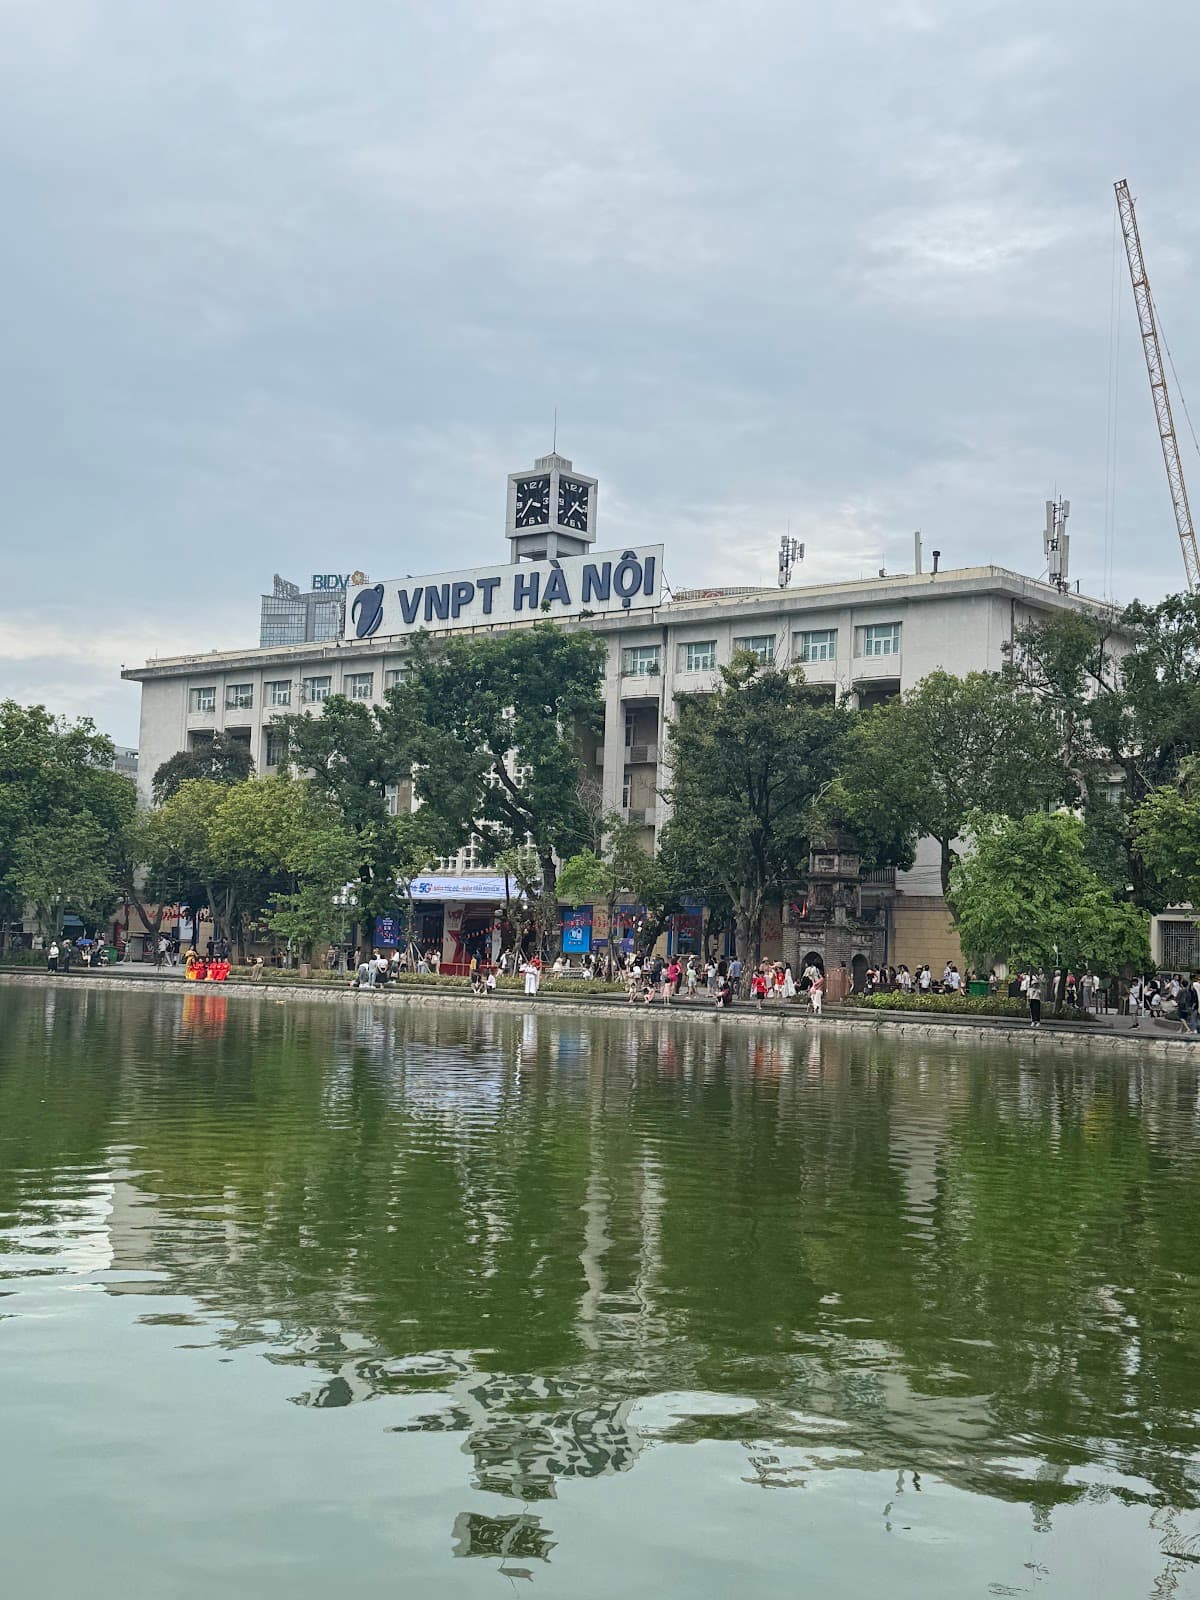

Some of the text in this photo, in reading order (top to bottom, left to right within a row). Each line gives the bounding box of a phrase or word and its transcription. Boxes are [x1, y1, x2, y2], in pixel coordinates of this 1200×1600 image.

[570, 484, 577, 492] 12
[542, 497, 549, 505] 3
[528, 517, 535, 525] 6
[312, 574, 351, 591] BIDV
[397, 550, 656, 625] VNPT HÀ NỘI
